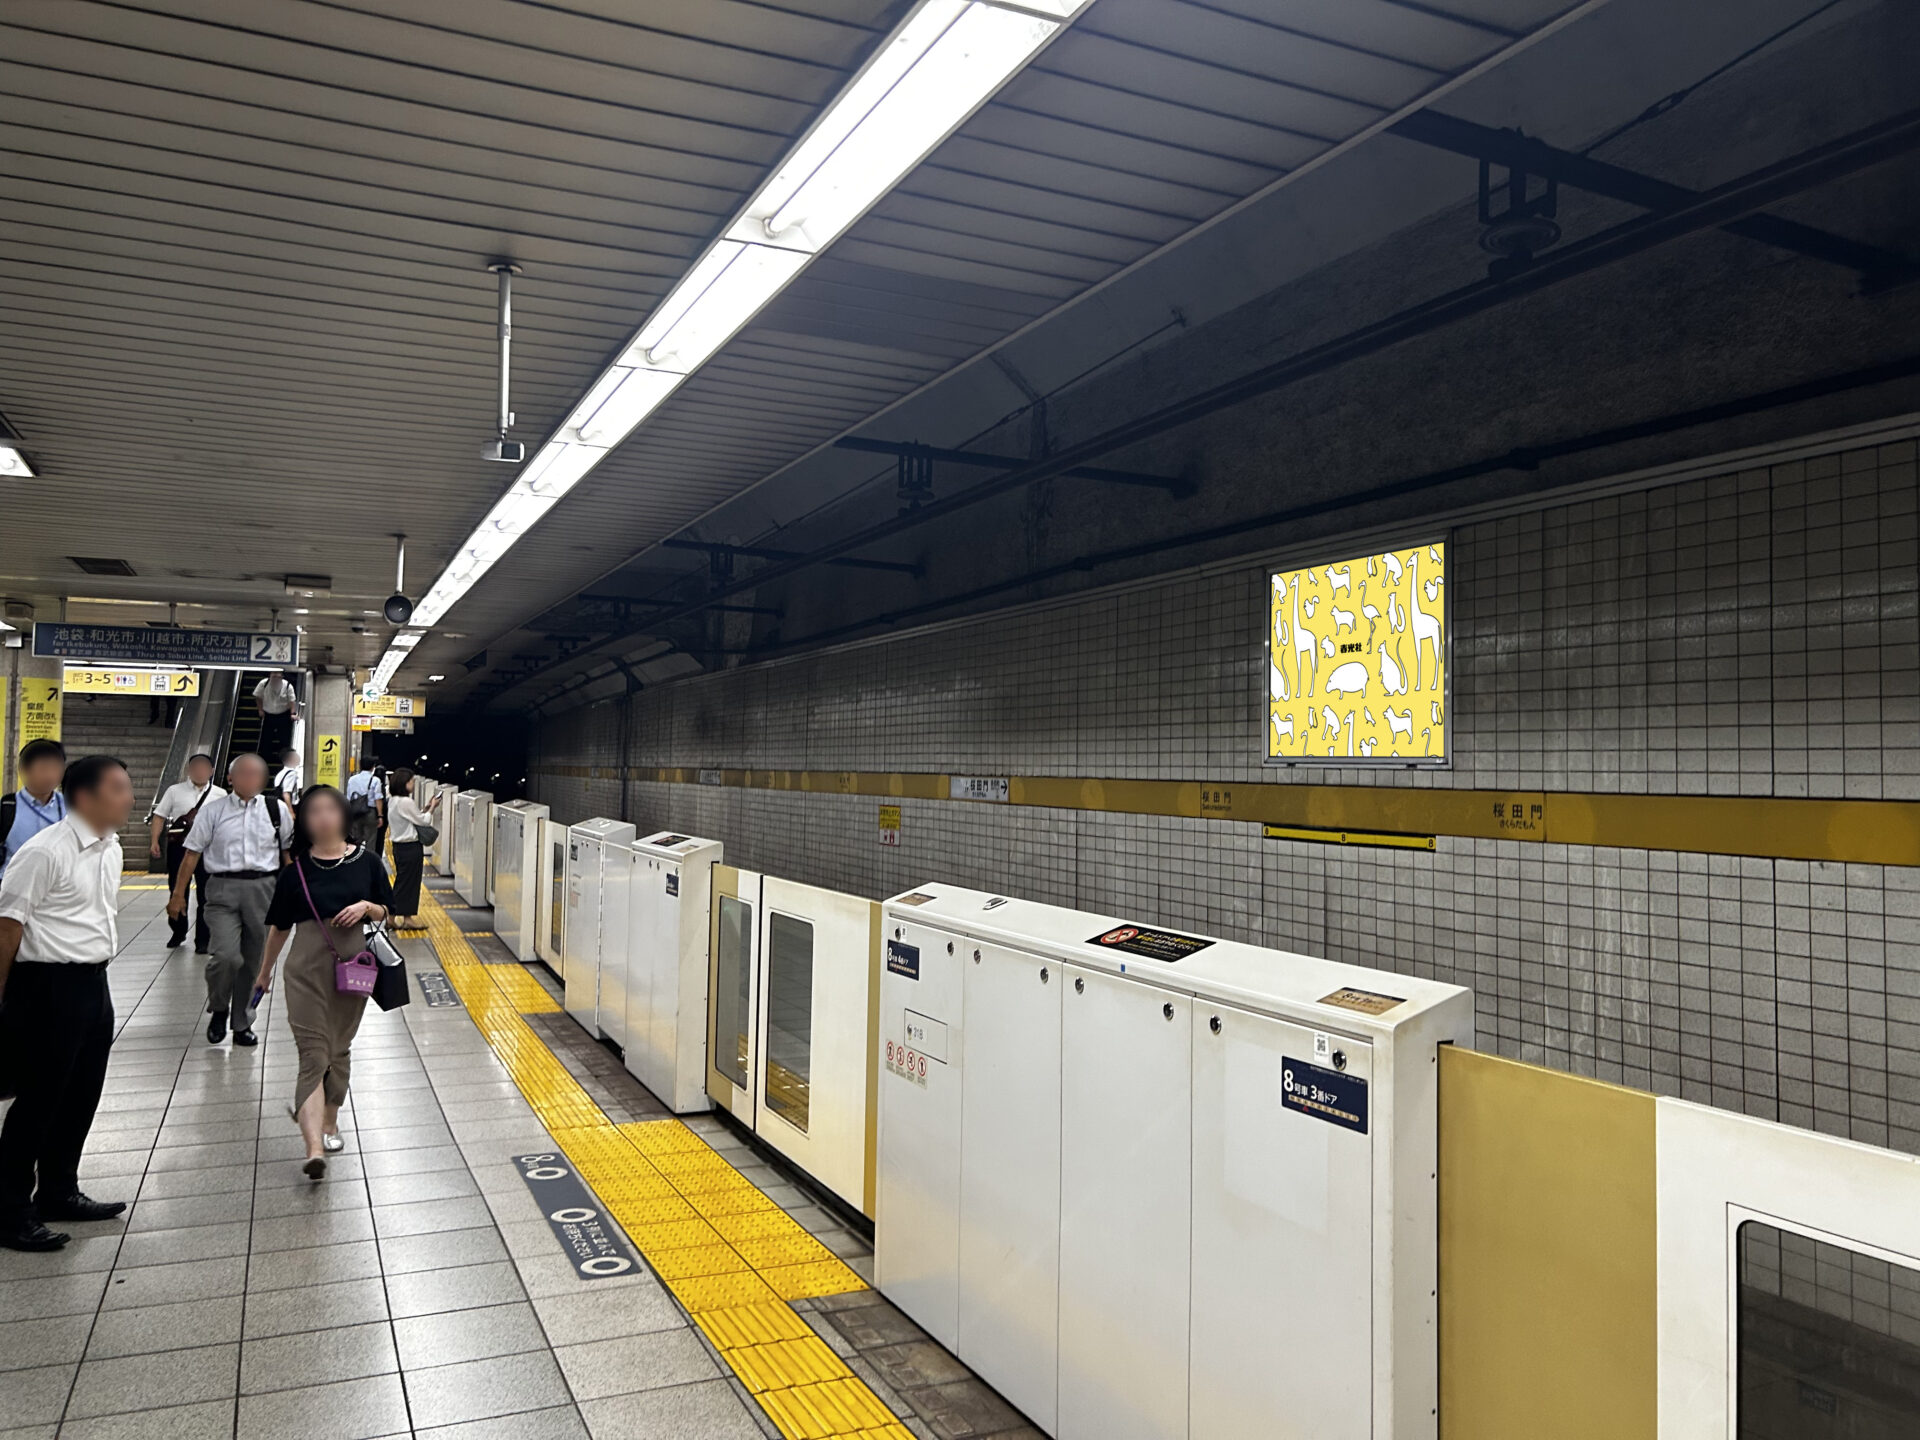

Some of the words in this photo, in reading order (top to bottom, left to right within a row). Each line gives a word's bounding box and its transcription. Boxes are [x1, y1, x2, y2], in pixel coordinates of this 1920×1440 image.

[66, 641, 110, 650] Ikebukuro,
[255, 637, 272, 660] 2
[1493, 802, 1543, 820] 桜田門
